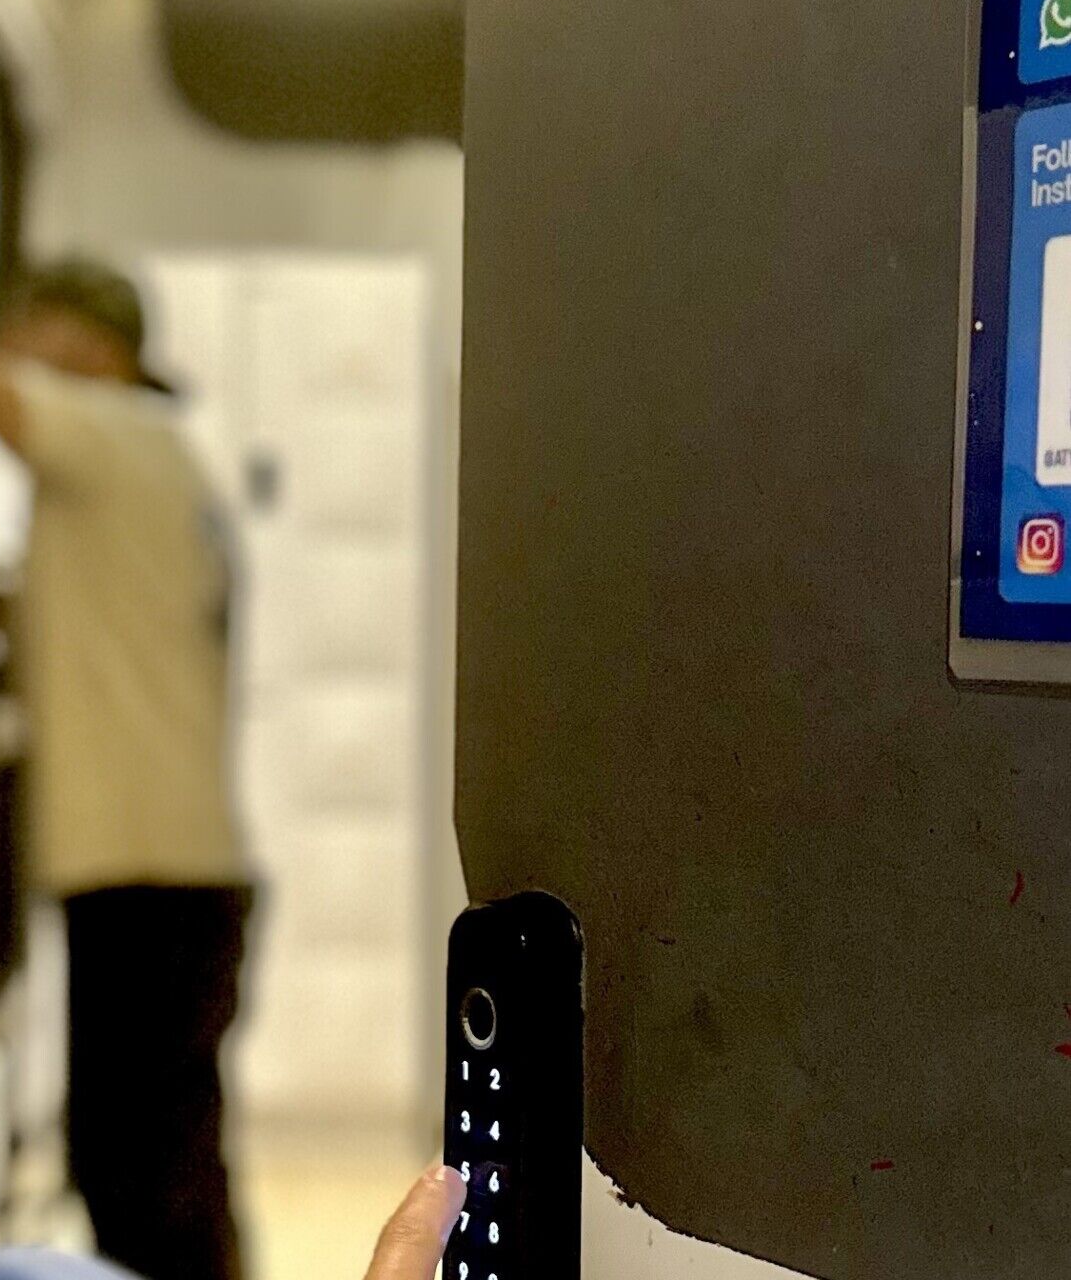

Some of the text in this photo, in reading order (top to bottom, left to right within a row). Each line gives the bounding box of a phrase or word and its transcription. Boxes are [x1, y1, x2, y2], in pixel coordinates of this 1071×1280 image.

[461, 1060, 501, 1090] 1 2
[460, 1110, 500, 1141] 3 4
[460, 1160, 500, 1193] 5 6
[459, 1210, 500, 1244] 7 8
